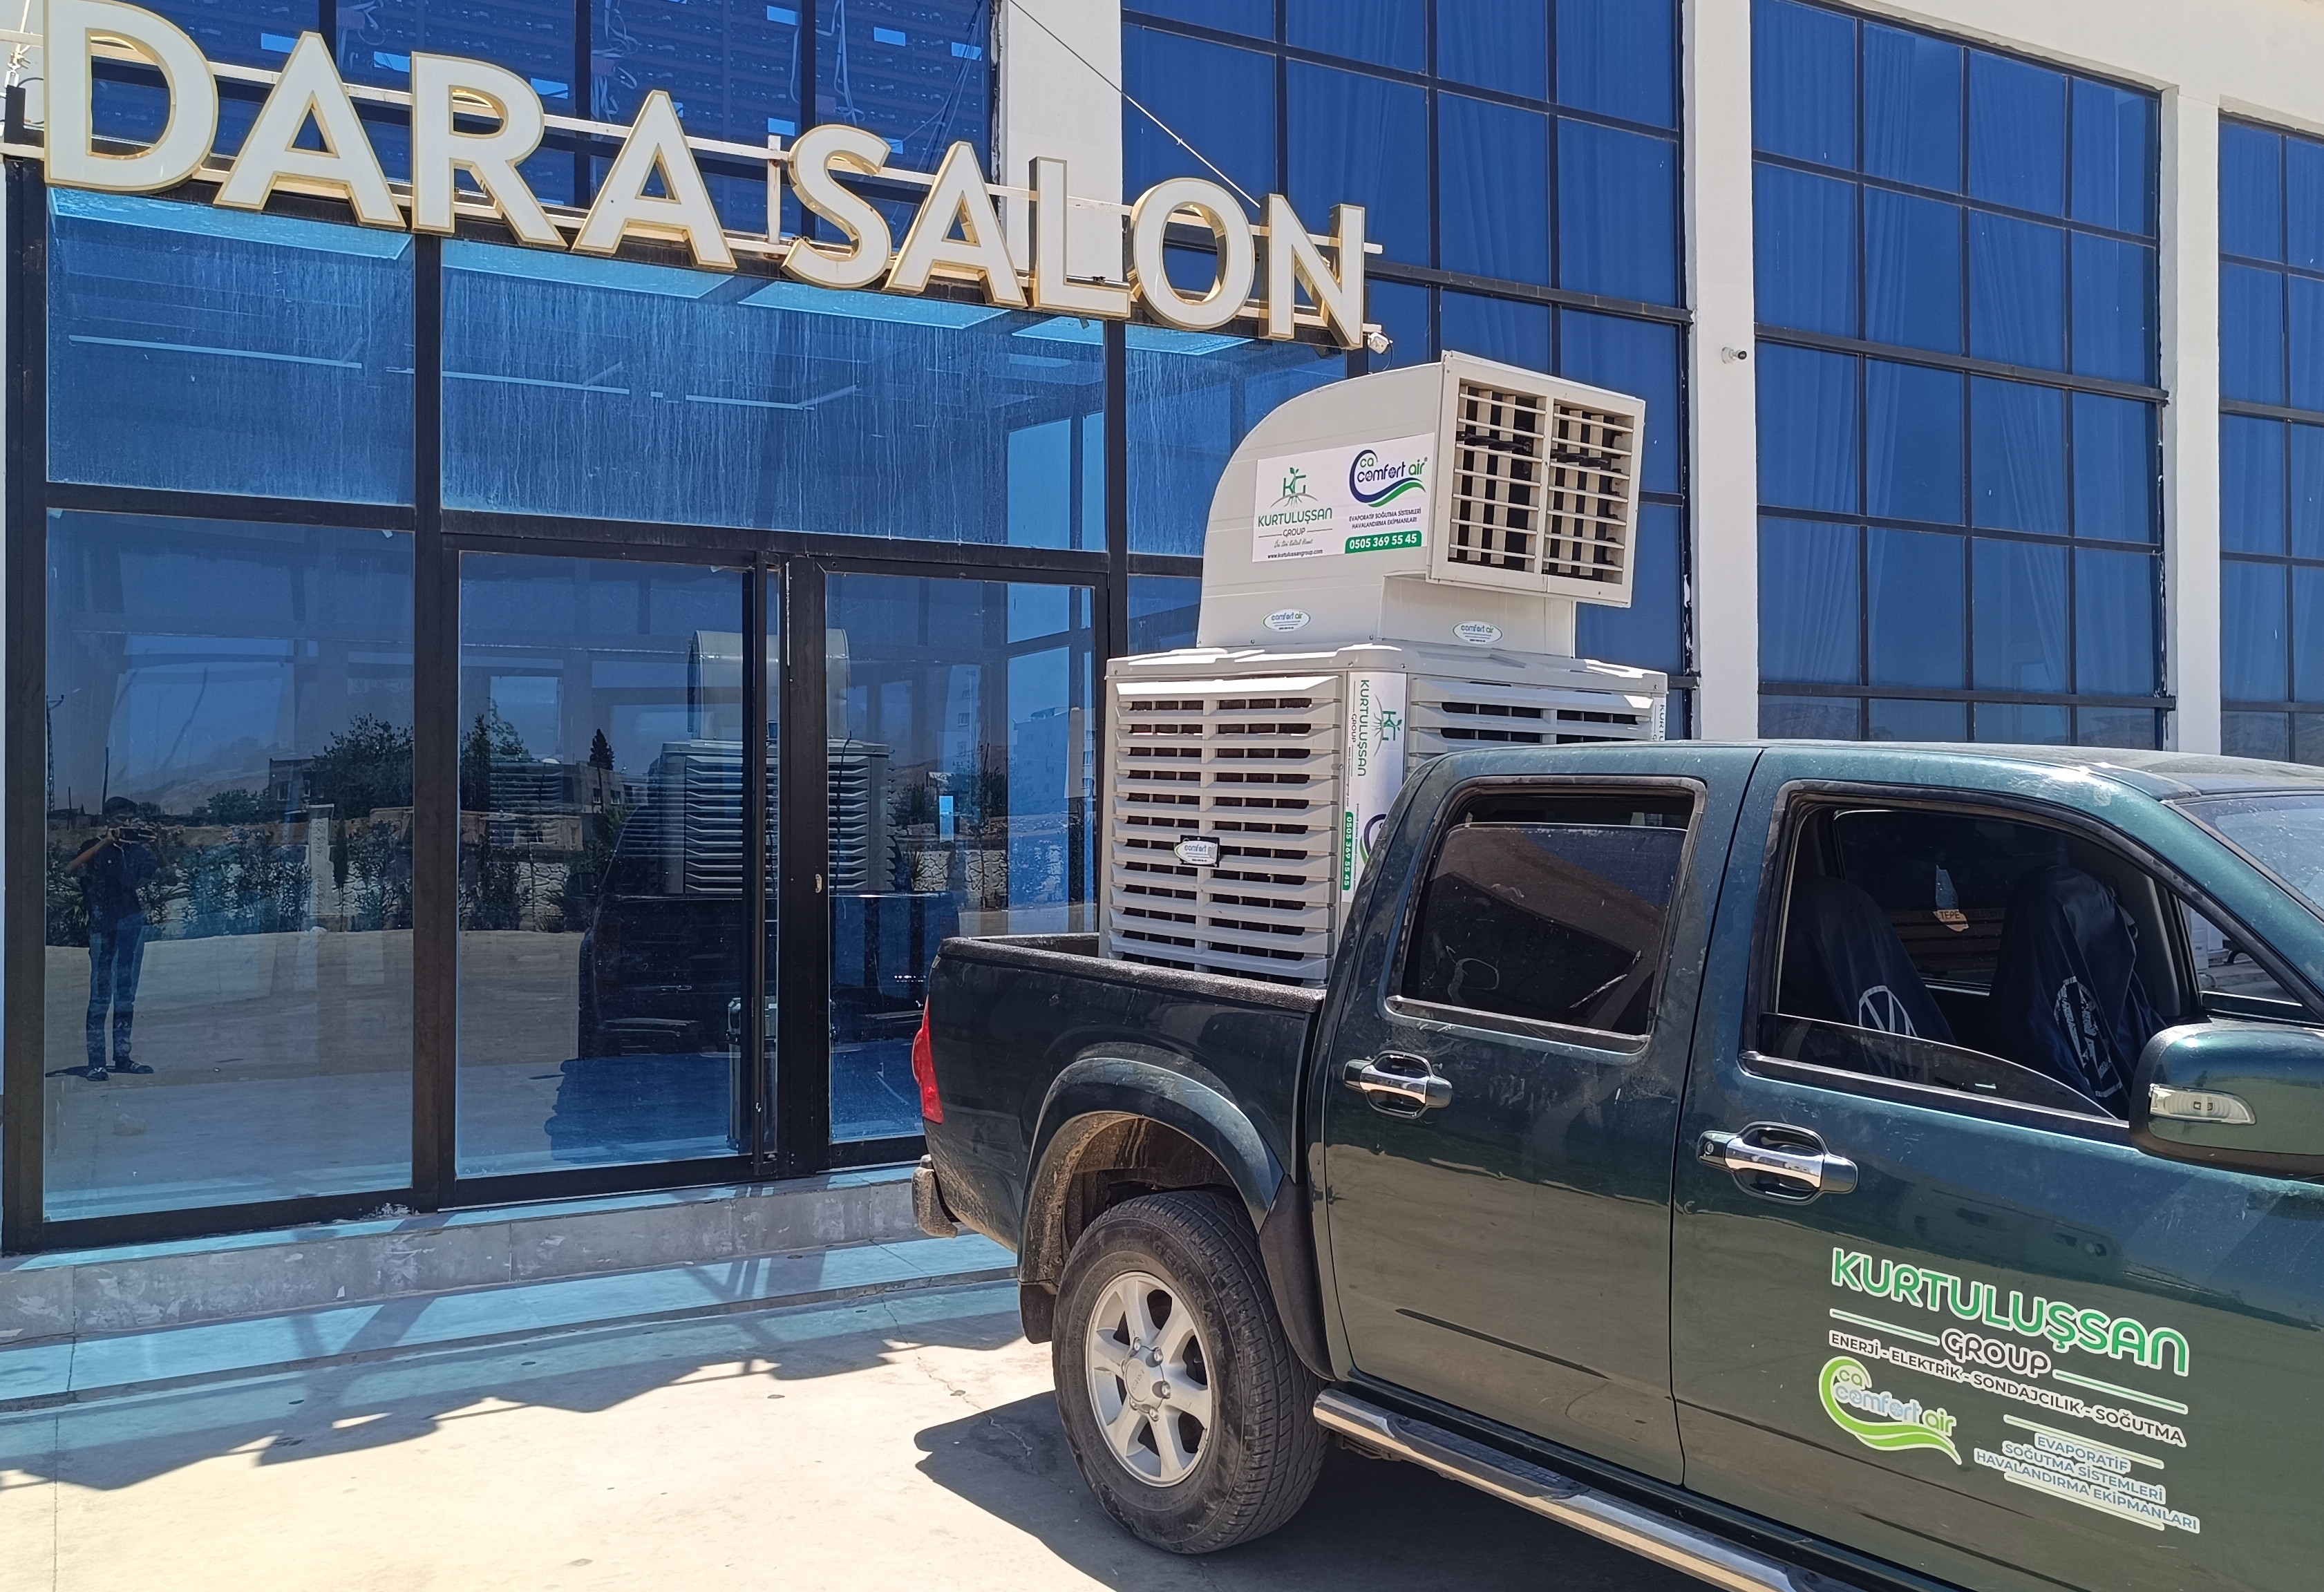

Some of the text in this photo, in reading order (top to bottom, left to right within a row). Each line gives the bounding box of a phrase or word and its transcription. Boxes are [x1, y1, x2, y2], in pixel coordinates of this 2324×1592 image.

[43, 0, 1366, 350] DARA SALON
[1357, 461, 1406, 483] comfort
[1258, 507, 1332, 527] KURTULUŞSAN
[1349, 506, 1421, 522] EVAPORATİF SOĞUTMA SİSTEMLERİ
[1352, 517, 1417, 529] HAVALANDIRMA EKİPMANLARI
[1283, 527, 1305, 538] GROUP
[1349, 533, 1417, 549] 0505 369 55 45
[1272, 612, 1294, 621] comfort
[1460, 624, 1485, 633] comfort
[1357, 679, 1370, 777] KURTULUŞSAN
[1344, 861, 1351, 873] 55
[1343, 874, 1350, 886] 45
[1833, 1249, 2188, 1375] KURTULUŞSAN
[1943, 1330, 2049, 1376] GROUP
[1831, 1333, 1879, 1355] ENERJİ
[1891, 1350, 1962, 1380] ELEKTRİK
[1973, 1374, 2081, 1414] SONDAJCILIK
[2095, 1408, 2184, 1444] SOĞUTMA
[1838, 1369, 1863, 1387] ca
[1835, 1385, 1954, 1433] comfort air
[2037, 1436, 2128, 1472] EVAPORATİF
[2005, 1443, 2164, 1501] SOĞUTMA SİSTEMLERİ
[1976, 1451, 2197, 1531] HAVALANDIRMA EKİPMANLARI
